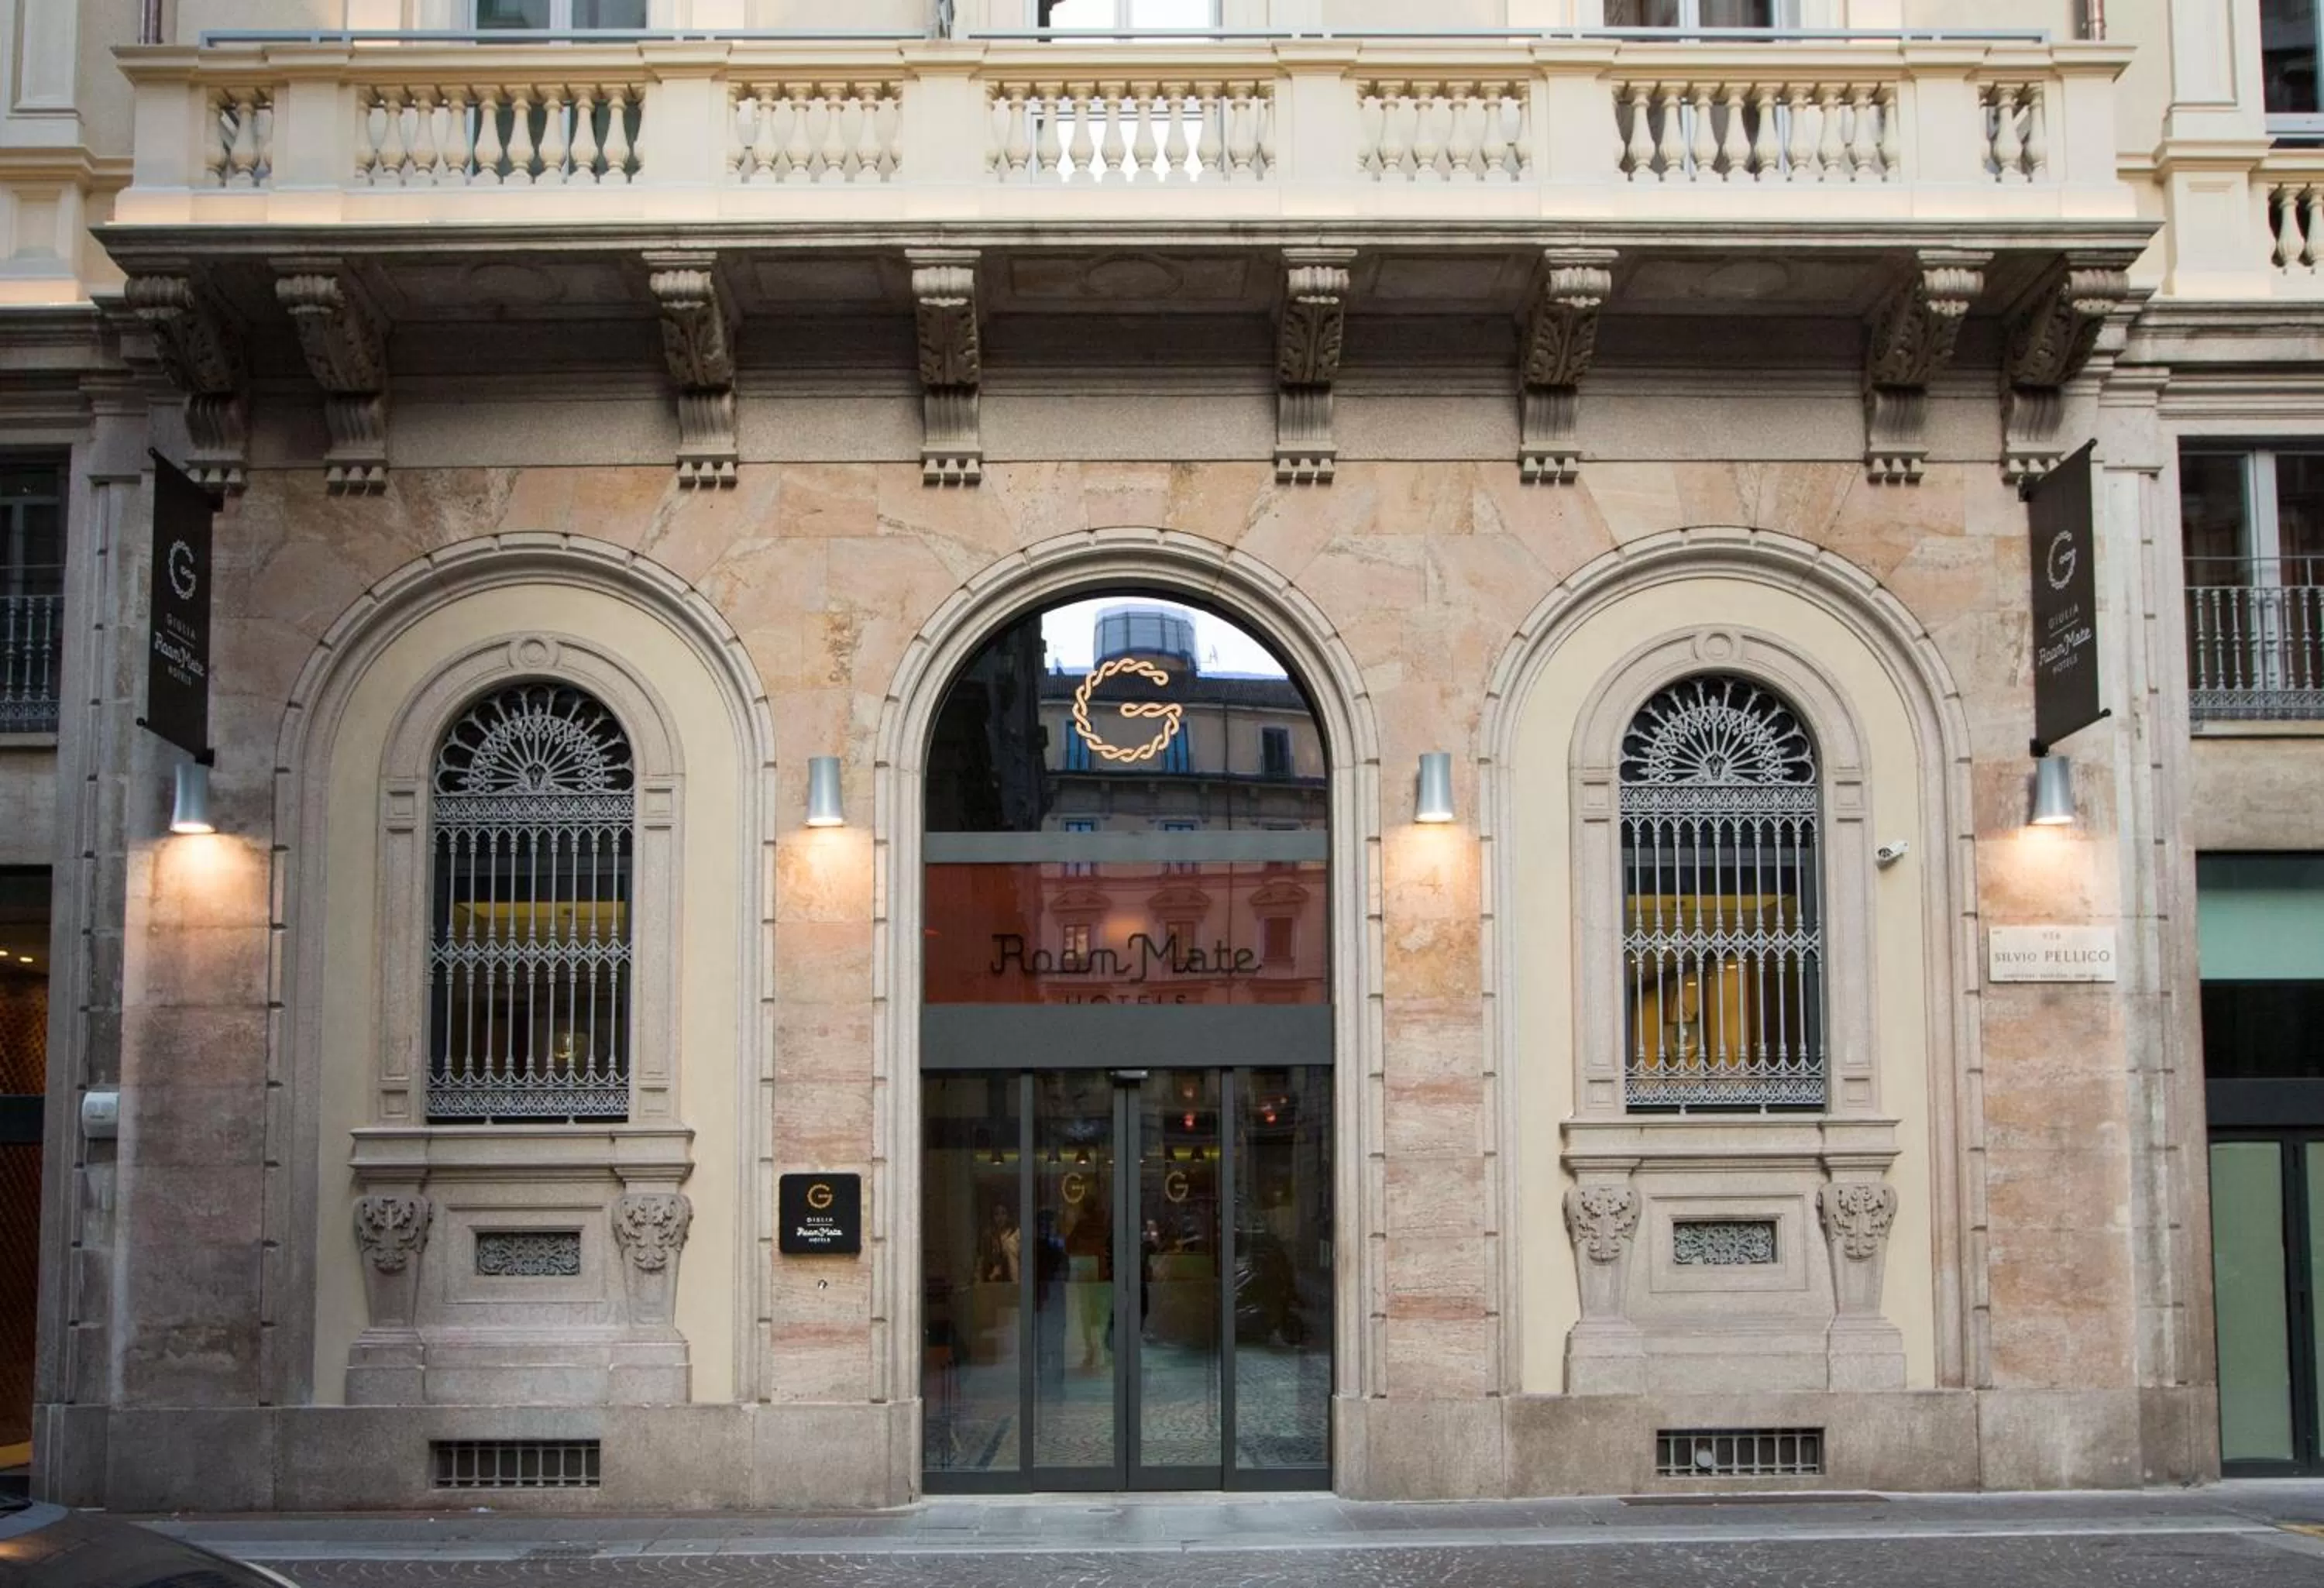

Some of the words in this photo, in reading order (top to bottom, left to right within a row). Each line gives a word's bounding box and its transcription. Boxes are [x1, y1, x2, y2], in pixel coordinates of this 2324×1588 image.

[168, 539, 197, 600] G
[2047, 530, 2077, 589] G
[1072, 658, 1183, 763] G
[991, 933, 1133, 976] Room
[1128, 933, 1263, 983] Mate
[1995, 951, 2037, 963] SILVIO
[2045, 950, 2110, 963] PELLICO
[806, 1184, 833, 1208] G
[1061, 1172, 1085, 1204] G
[1165, 1170, 1189, 1203] G
